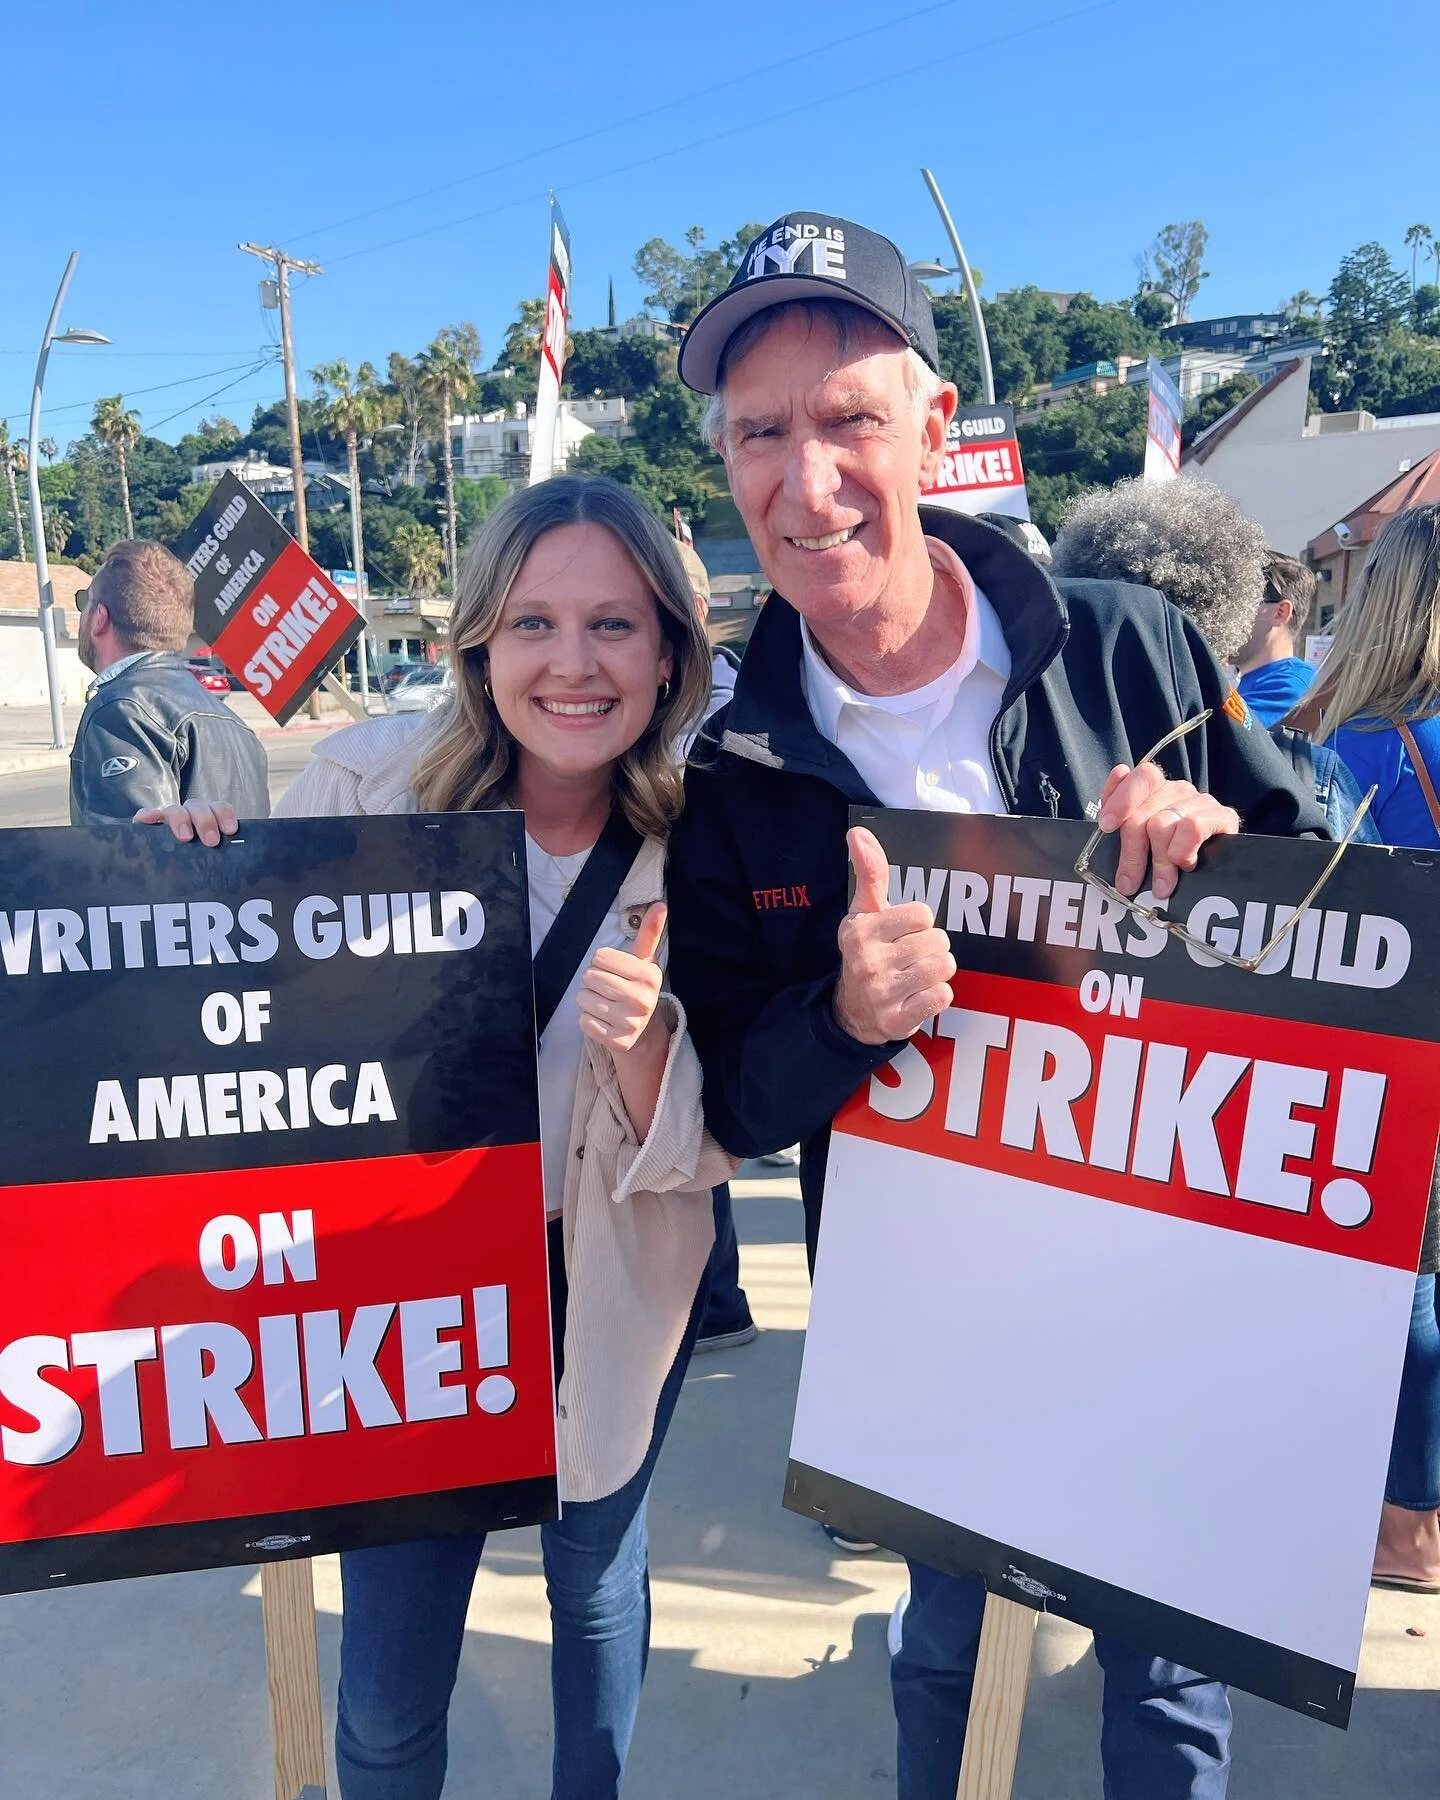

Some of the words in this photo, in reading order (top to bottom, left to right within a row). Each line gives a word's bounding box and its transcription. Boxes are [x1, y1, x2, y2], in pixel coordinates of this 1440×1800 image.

[772, 224, 819, 244] END
[825, 227, 844, 241] IS
[962, 417, 1006, 437] GUILD
[937, 447, 1014, 488] RIKE!
[187, 534, 219, 582] ITERS
[213, 495, 247, 540] GUILD
[216, 553, 231, 575] OF
[214, 549, 265, 616] AMERICA
[252, 593, 280, 627] ON
[243, 577, 338, 697] STRIKE!
[293, 890, 486, 960] GUILD
[753, 886, 811, 909] ETFLIX
[1186, 895, 1412, 989] GUILD
[201, 990, 271, 1046] OF
[1079, 969, 1144, 1019] ON
[89, 1061, 398, 1144] AMERICA
[199, 1209, 317, 1291] ON
[0, 1284, 517, 1466] STRIKE!
